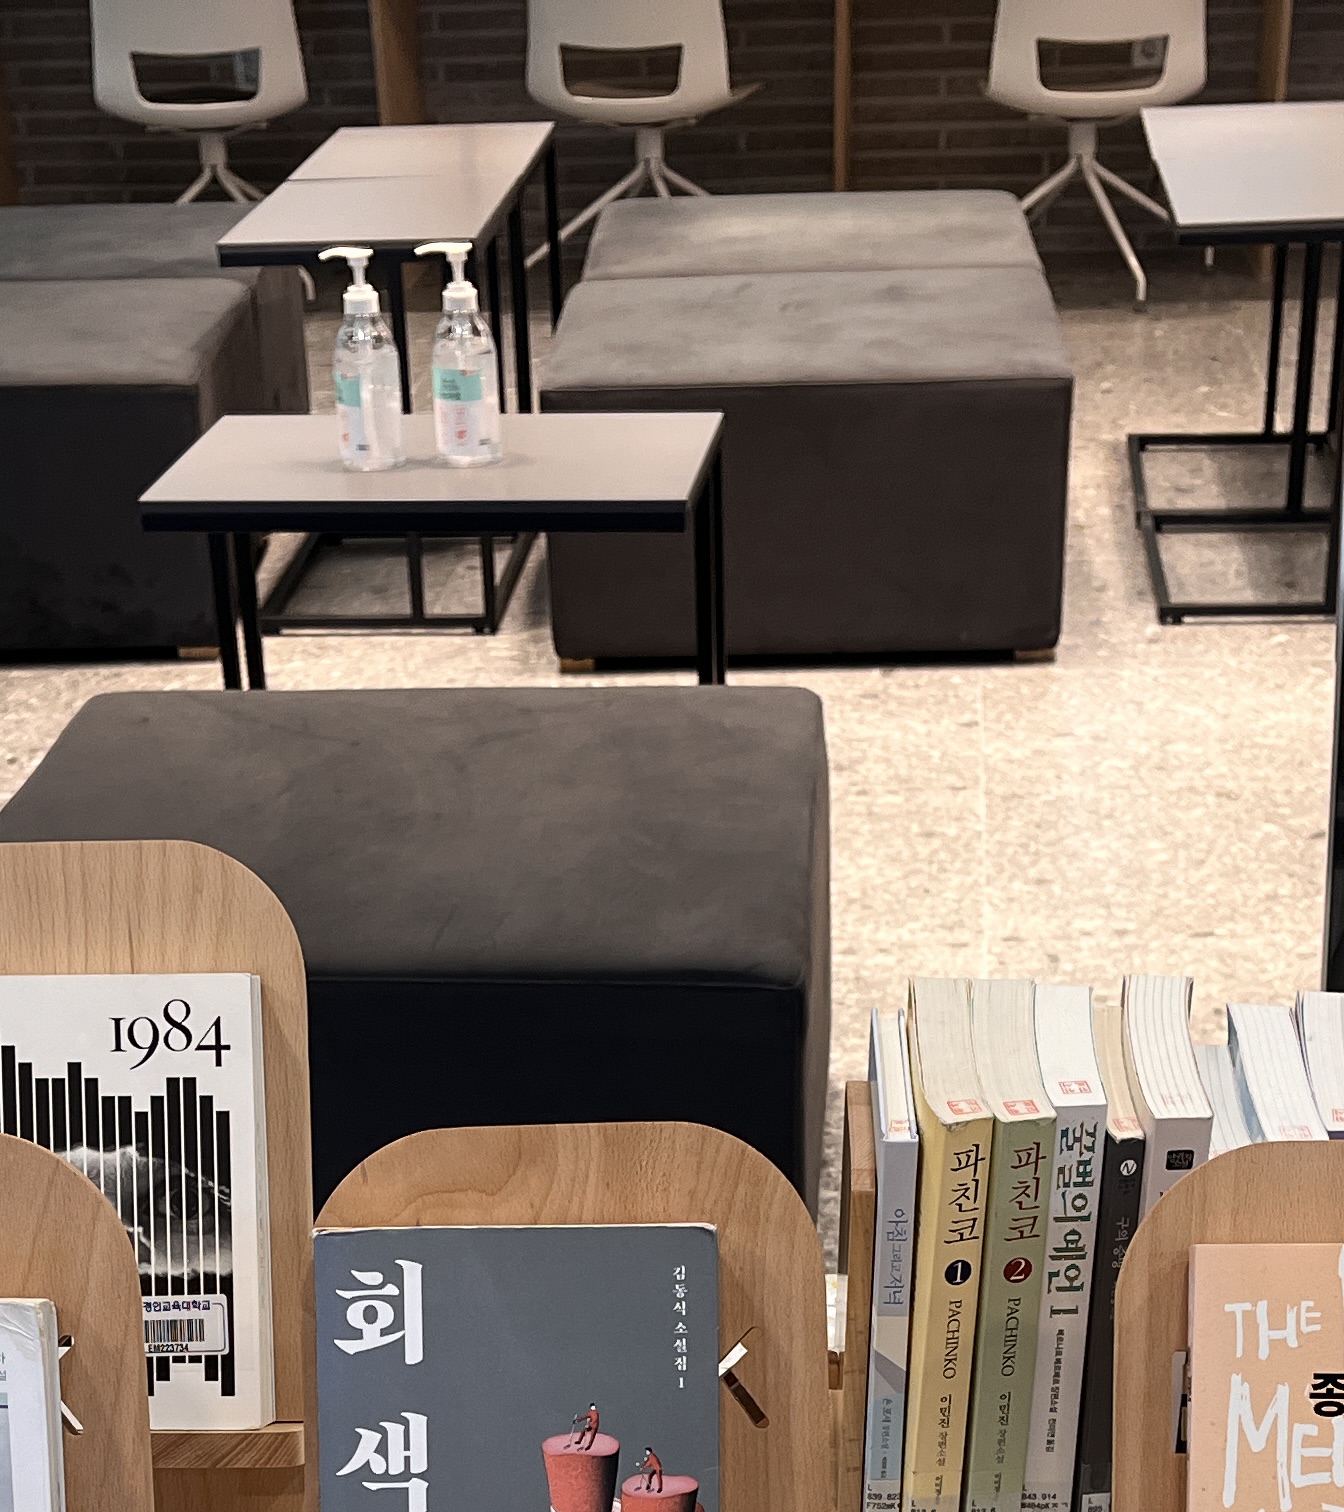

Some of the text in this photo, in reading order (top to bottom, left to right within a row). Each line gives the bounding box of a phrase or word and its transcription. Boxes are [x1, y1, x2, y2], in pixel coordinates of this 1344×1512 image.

[107, 999, 231, 1070] 1984
[943, 1143, 987, 1245] 파친코
[1003, 1141, 1047, 1243] 파친코
[672, 1265, 688, 1317] 김동식
[672, 1321, 689, 1372] 소설집
[943, 1299, 962, 1380] PACHINKO
[1001, 1298, 1021, 1378] PACHINKO
[1224, 1298, 1322, 1361] THE
[938, 1393, 952, 1429] 이민진
[997, 1391, 1011, 1427] 이민진
